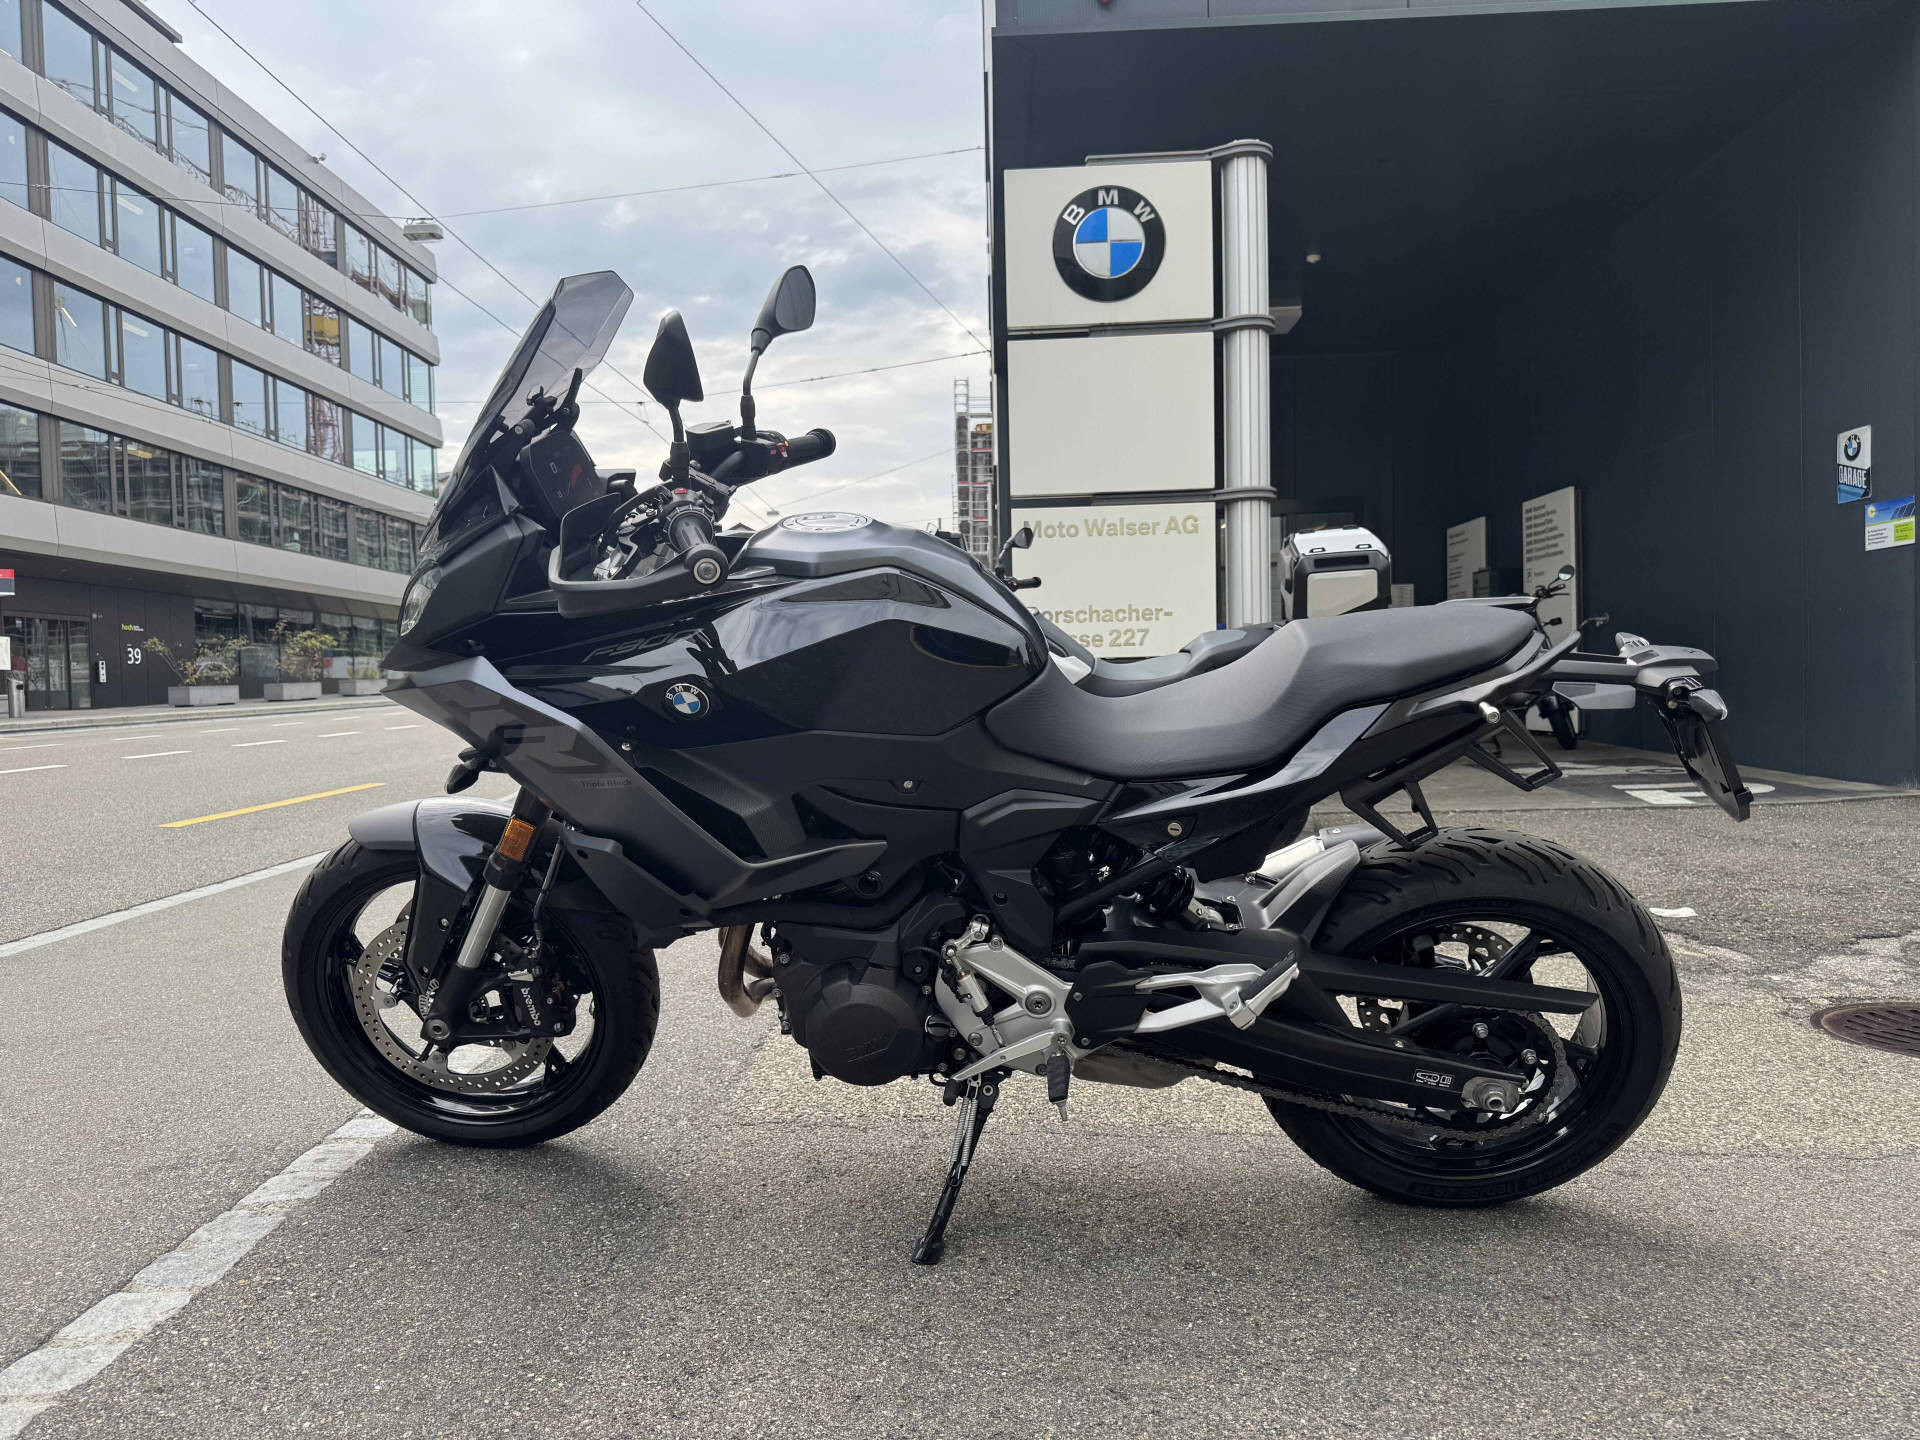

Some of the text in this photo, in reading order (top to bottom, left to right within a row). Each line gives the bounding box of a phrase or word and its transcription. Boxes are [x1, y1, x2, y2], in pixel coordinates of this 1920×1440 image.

[1062, 189, 1155, 226] BMW
[1838, 466, 1867, 488] GARAGE
[1084, 517, 1160, 537] Walser
[1164, 514, 1200, 534] AG
[1041, 604, 1173, 624] orschacher-
[1108, 628, 1150, 648] 227
[127, 648, 142, 664] 39
[665, 685, 700, 701] BMW
[520, 987, 541, 1026] brembo
